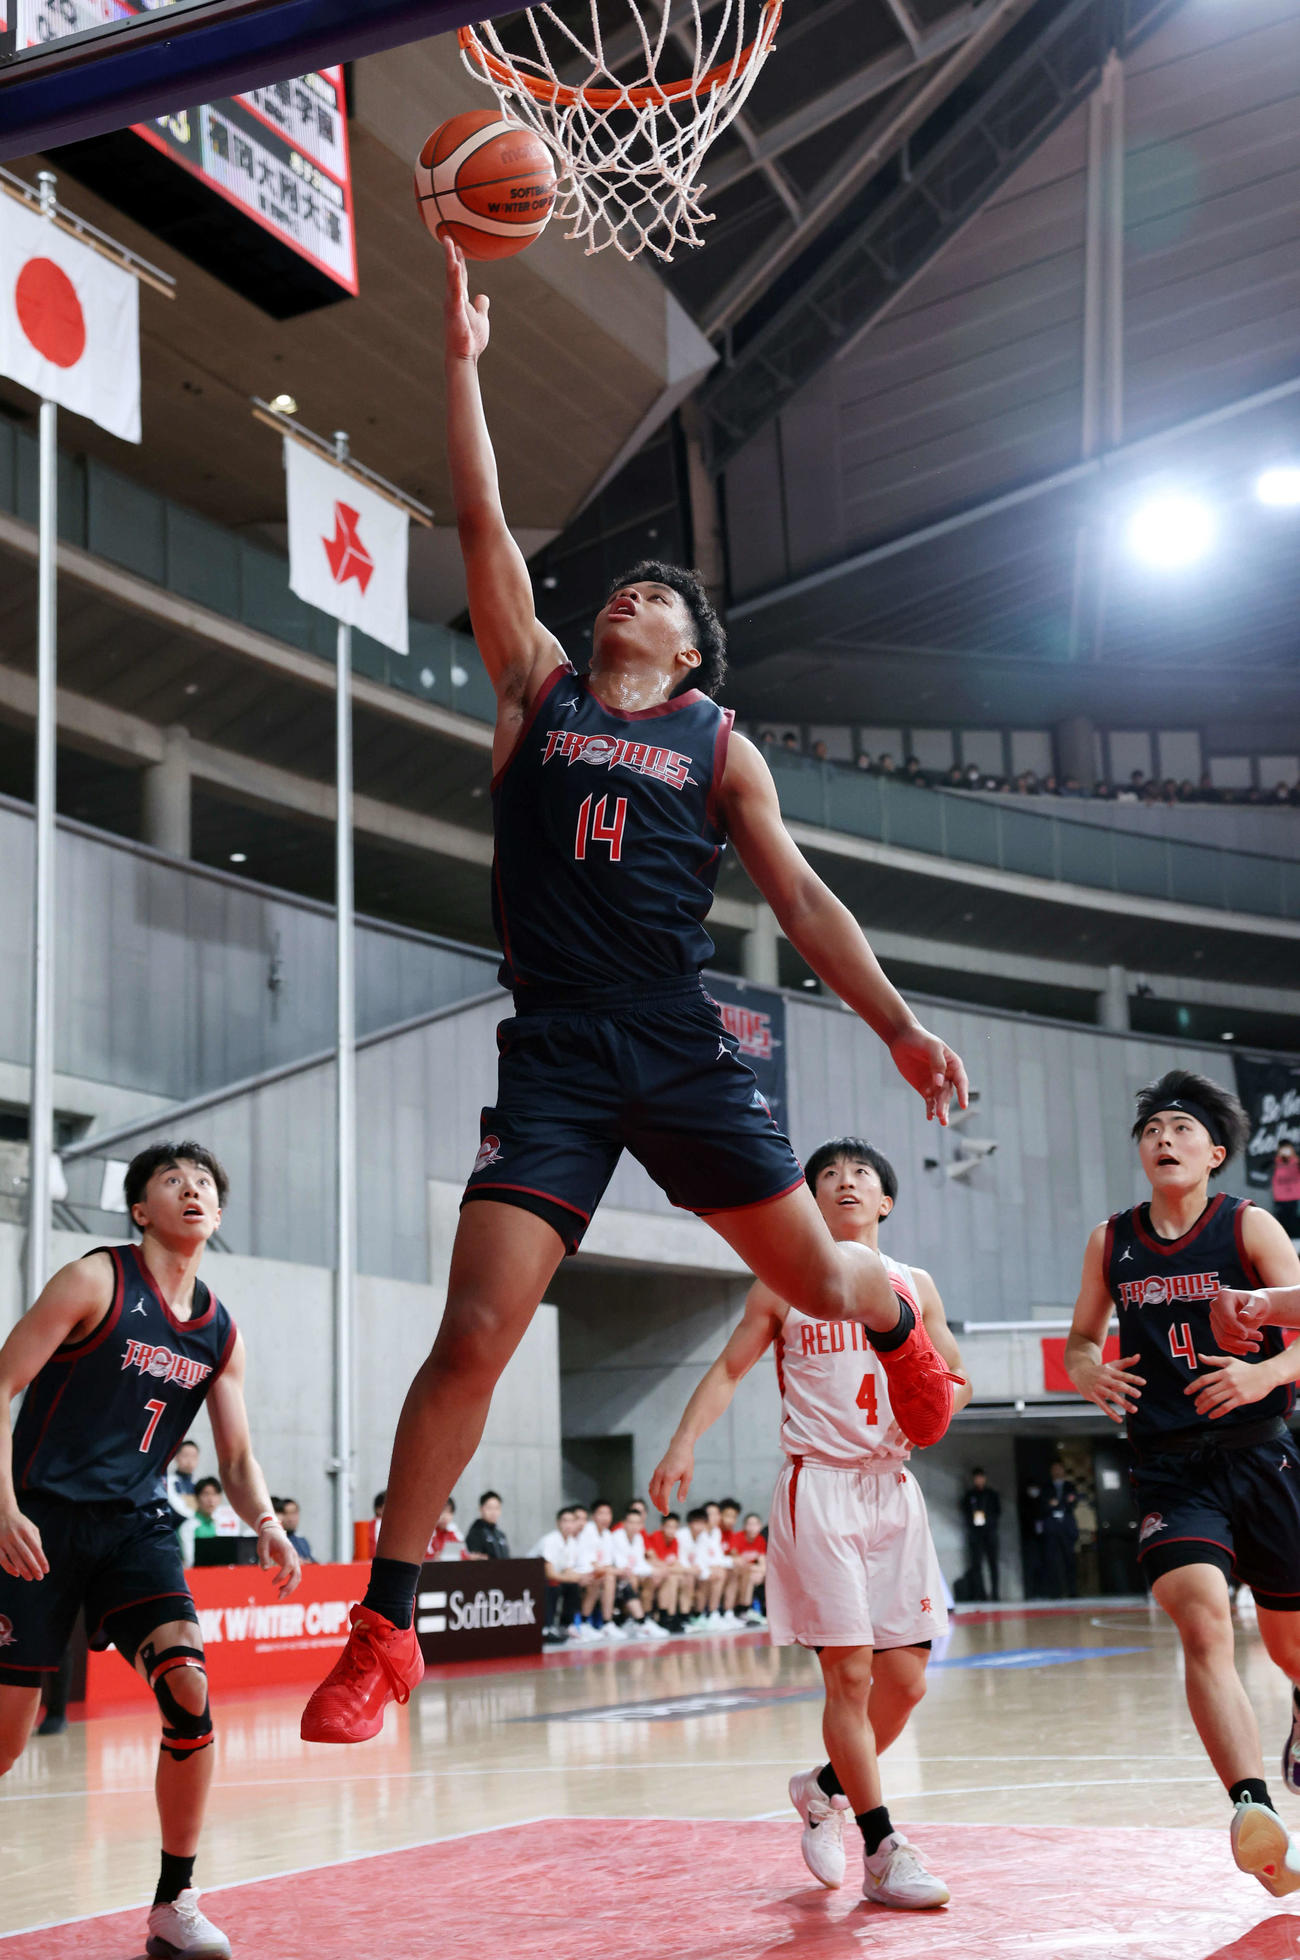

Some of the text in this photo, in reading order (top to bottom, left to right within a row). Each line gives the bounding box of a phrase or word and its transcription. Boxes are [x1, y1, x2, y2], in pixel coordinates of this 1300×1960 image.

[541, 730, 698, 790] TROJANS
[575, 793, 627, 861] 14
[1118, 1271, 1226, 1312] TROJANS
[801, 1321, 845, 1356] RED
[1168, 1322, 1198, 1370] 4
[855, 1373, 879, 1426] 4
[139, 1399, 167, 1453] 7
[305, 1601, 347, 1636] CUP
[448, 1588, 536, 1631] SoftBank
